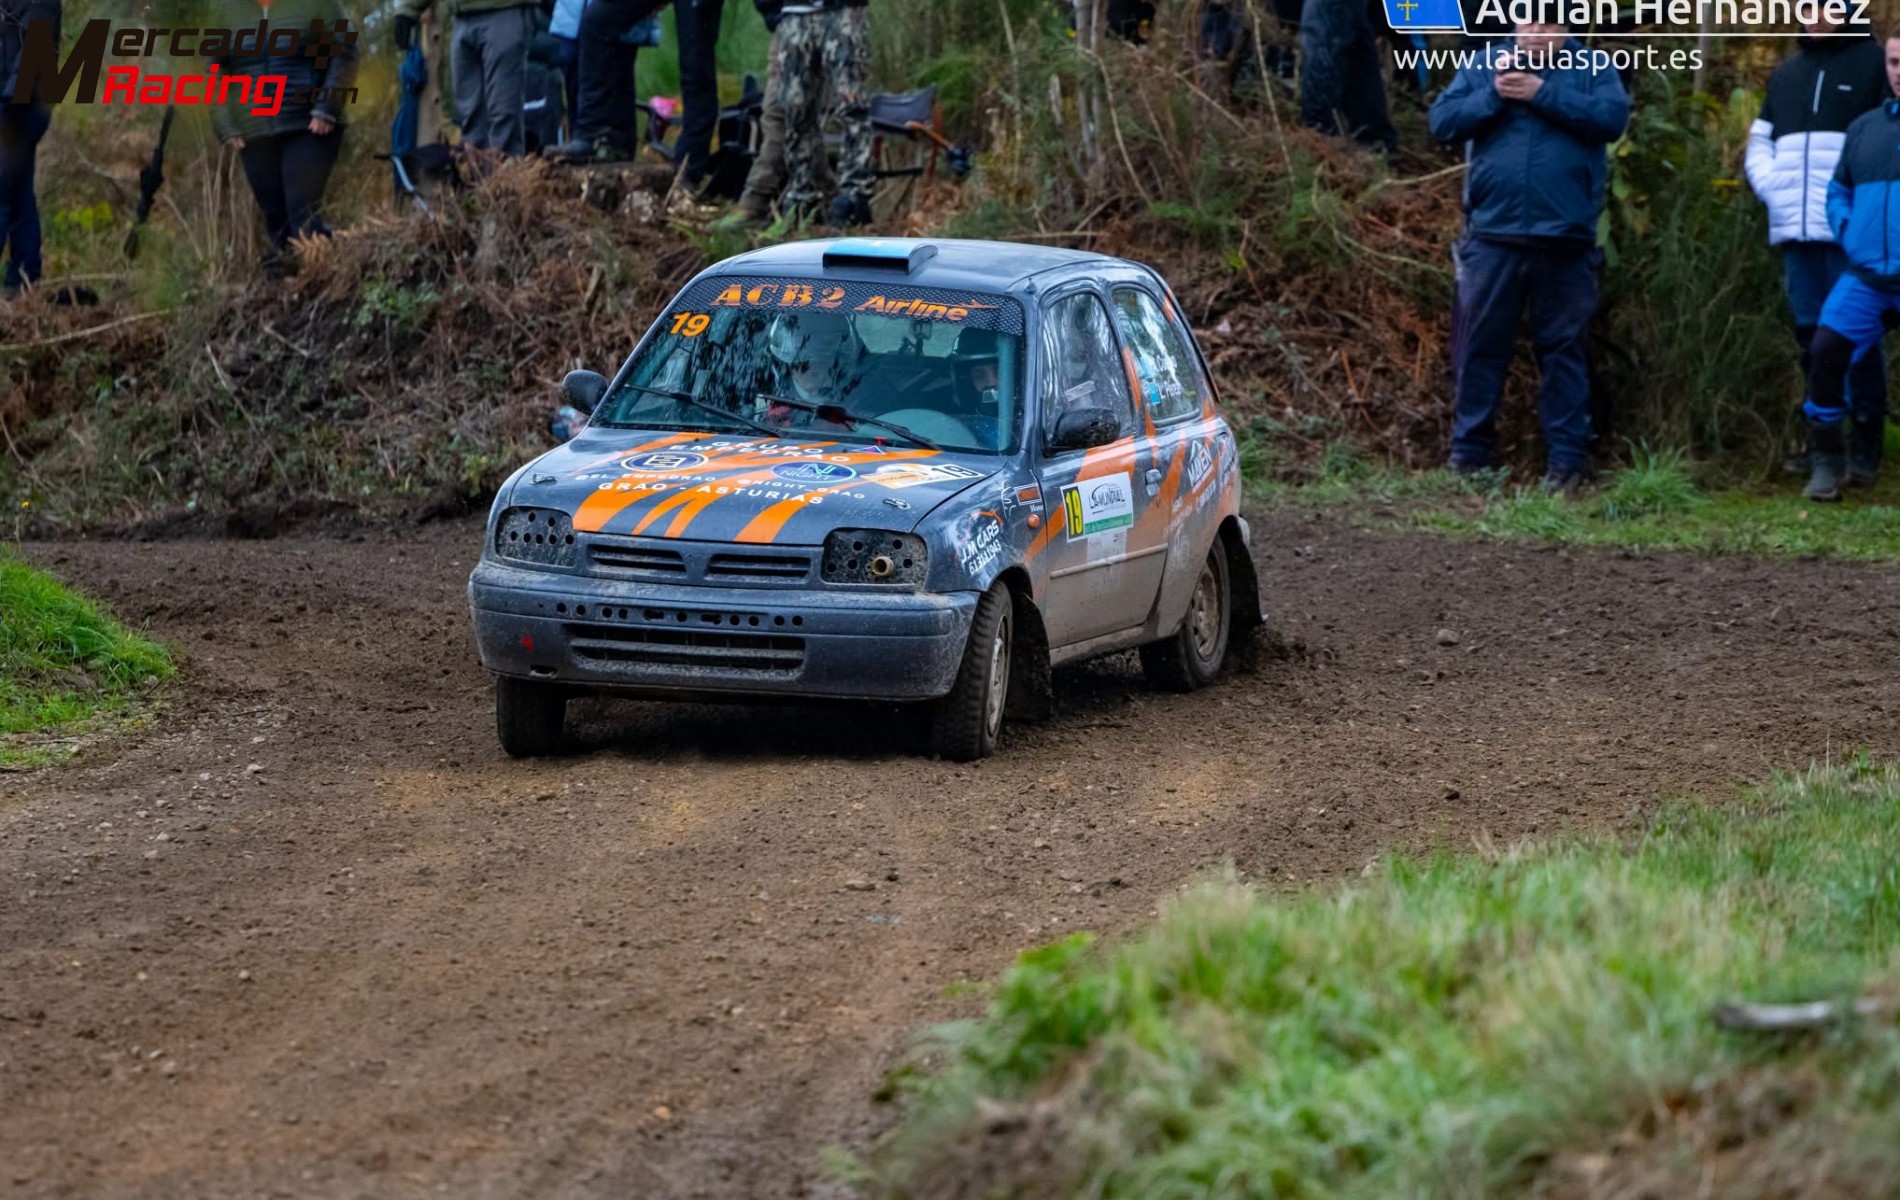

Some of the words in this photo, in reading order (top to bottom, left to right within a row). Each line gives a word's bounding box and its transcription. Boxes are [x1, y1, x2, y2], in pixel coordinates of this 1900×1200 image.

[854, 295, 969, 321] Airline
[670, 311, 710, 337] 19
[669, 444, 850, 462] EMPEDRAO
[711, 441, 824, 454] GRUPO
[780, 470, 832, 481] NIGHT
[931, 465, 979, 478] 19
[598, 482, 667, 491] GRAO
[697, 485, 824, 504] ASTURIAS
[1066, 489, 1083, 536] 19
[977, 519, 1000, 549] CARS
